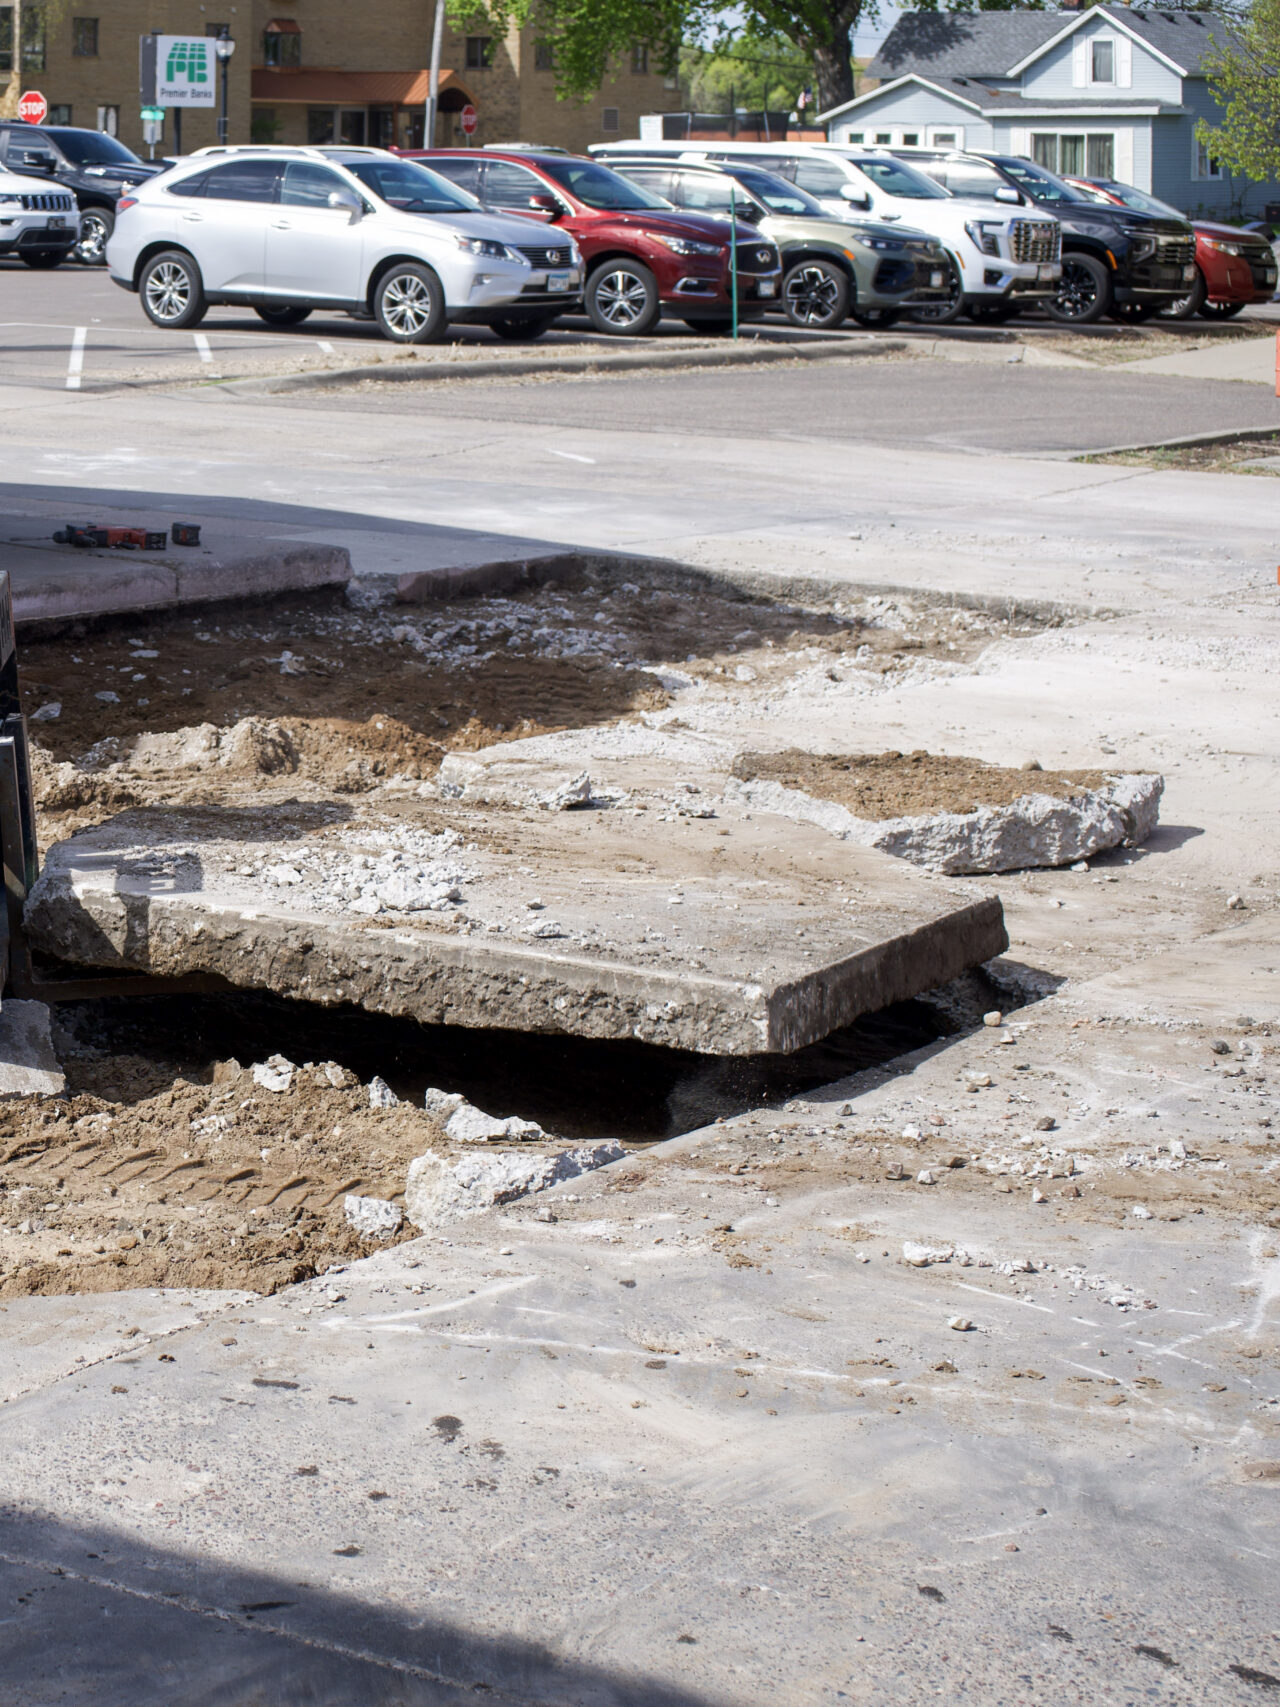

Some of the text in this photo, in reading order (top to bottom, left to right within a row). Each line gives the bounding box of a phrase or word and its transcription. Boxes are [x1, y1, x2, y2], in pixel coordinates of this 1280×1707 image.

[160, 88, 213, 99] Premier Banks
[21, 102, 45, 115] STOP
